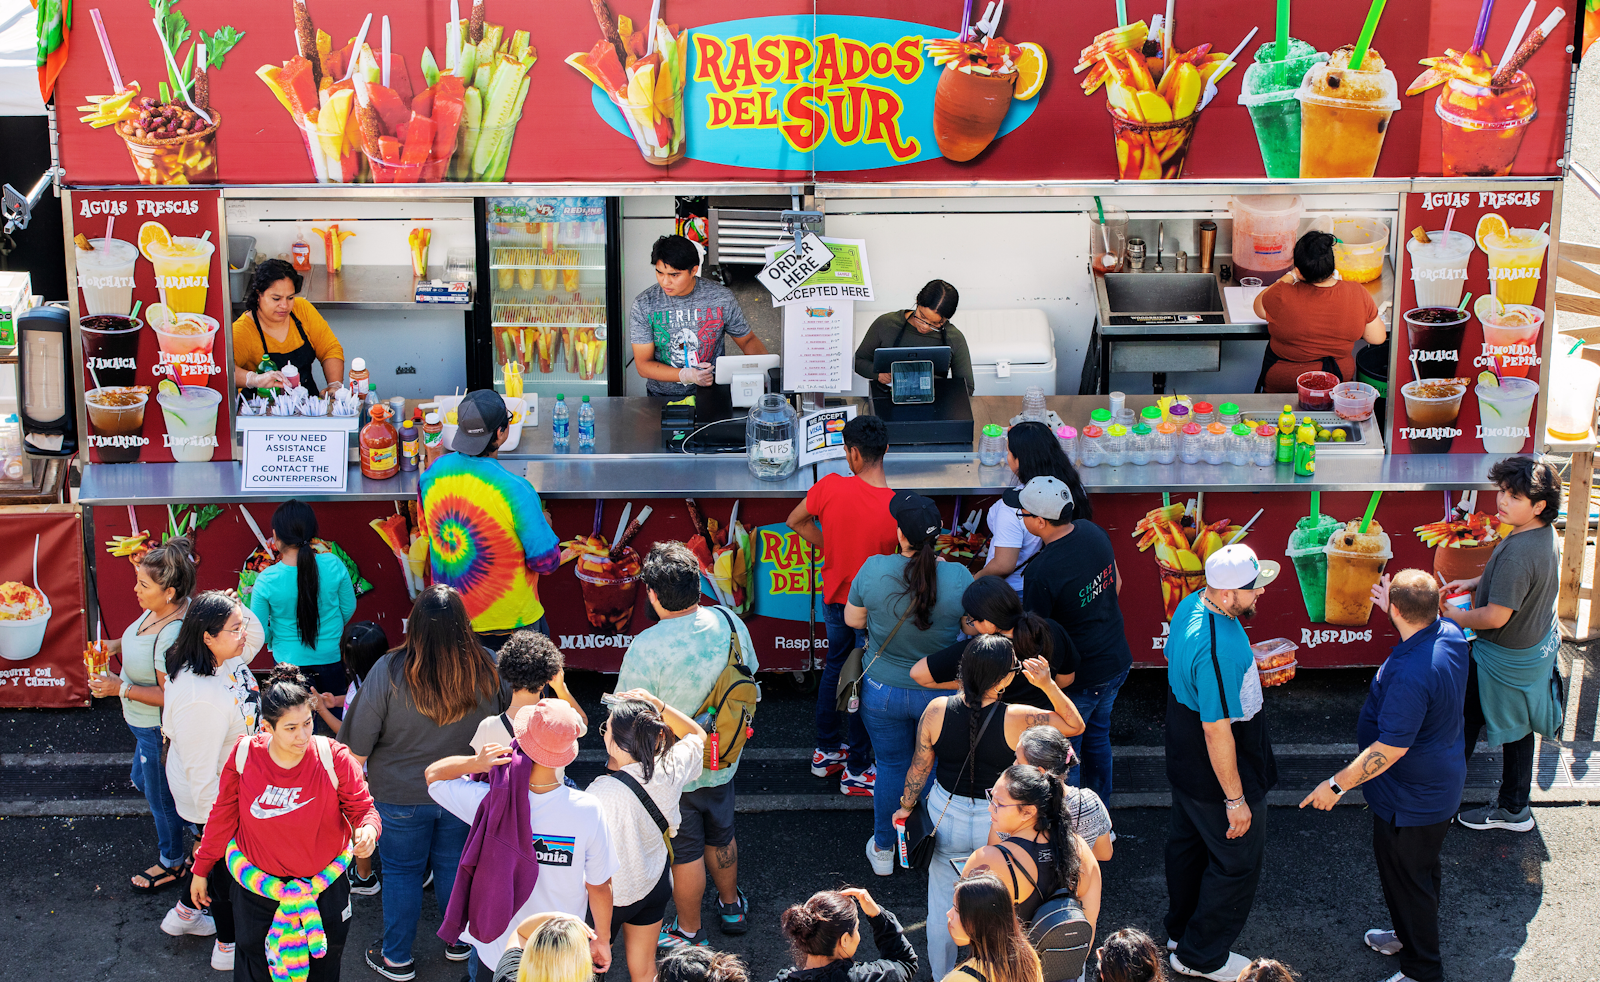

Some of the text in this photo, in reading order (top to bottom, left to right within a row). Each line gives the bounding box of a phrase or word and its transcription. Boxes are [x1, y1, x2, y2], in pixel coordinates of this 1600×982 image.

[692, 33, 924, 93] RASPADOS
[706, 83, 921, 162] DEL SUR
[1422, 192, 1541, 210] AGUAS FRESCAS
[80, 200, 199, 218] AGUAS FRESCAS
[494, 204, 527, 217] bang
[782, 256, 820, 289] HERE
[1410, 267, 1468, 282] HORCHATA
[1487, 267, 1541, 281] NARANJA
[77, 275, 136, 290] HORCHATA
[155, 275, 209, 290] NARANJA
[841, 286, 870, 298] HERE
[1408, 349, 1459, 362] JAMAICA
[1481, 342, 1536, 357] LIMONADA
[86, 356, 137, 370] JAMAICA
[157, 351, 214, 365] LIMONADA
[1473, 355, 1542, 368] CON PEPINO
[152, 364, 221, 376] CON PEPINO
[818, 412, 844, 422] ACCEPT
[810, 425, 822, 435] VISA
[1400, 427, 1462, 440] TAMARINDO
[1475, 425, 1530, 439] LIMONADA
[87, 435, 150, 448] TAMARINDO
[163, 434, 219, 448] LIMONADA
[265, 434, 328, 442] IF YOU NEED
[266, 444, 326, 452] ASSISTANCE
[765, 443, 789, 454] TIPS
[261, 465, 329, 473] CONTACT THE
[252, 475, 337, 483] COUNTERPERSON
[769, 568, 824, 595] DEL
[1079, 563, 1113, 598] CHAVEZ
[1080, 575, 1114, 608] ZUNIGA
[558, 634, 634, 650] MANGONE
[1300, 627, 1373, 649] RASPADOS
[35, 667, 52, 677] CON
[11, 677, 20, 686] Y
[25, 676, 65, 687] CHEETOS
[259, 784, 303, 807] NIKE
[536, 851, 568, 864] onia
